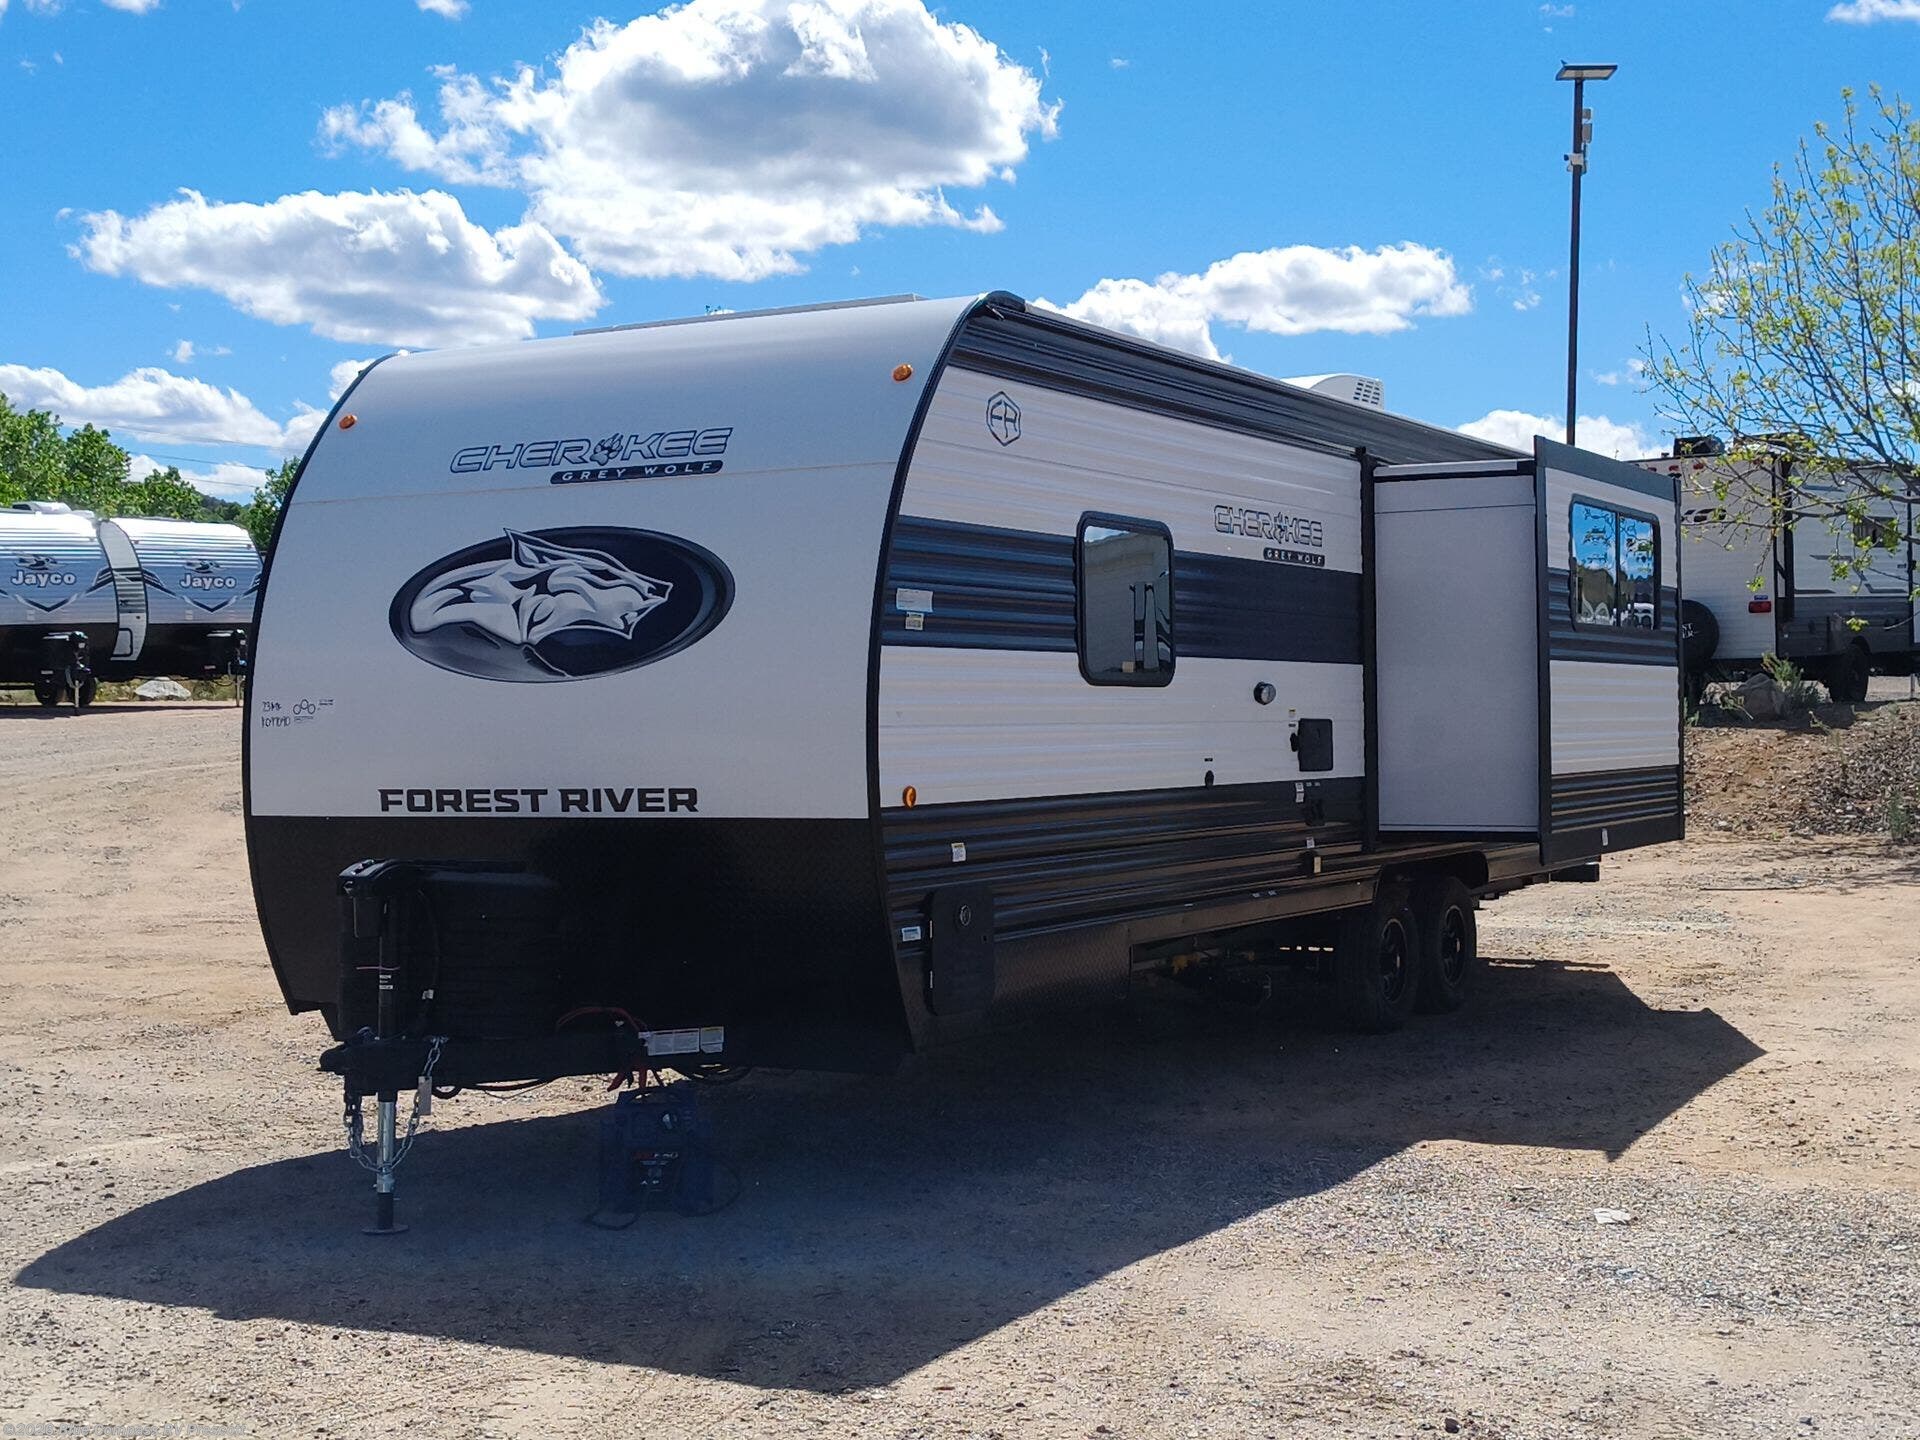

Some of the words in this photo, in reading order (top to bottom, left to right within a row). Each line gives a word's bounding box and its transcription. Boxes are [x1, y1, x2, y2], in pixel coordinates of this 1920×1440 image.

[450, 427, 734, 473] CHEROKEE
[561, 467, 627, 481] GREY
[643, 461, 715, 475] WOLF
[1213, 504, 1323, 547] CHEROKEE
[1266, 549, 1293, 561] GREY
[1297, 553, 1323, 565] WOLF
[11, 570, 77, 589] Jayco
[179, 573, 237, 590] Jayco
[377, 788, 548, 813] FOREST
[557, 788, 700, 813] RIVER
